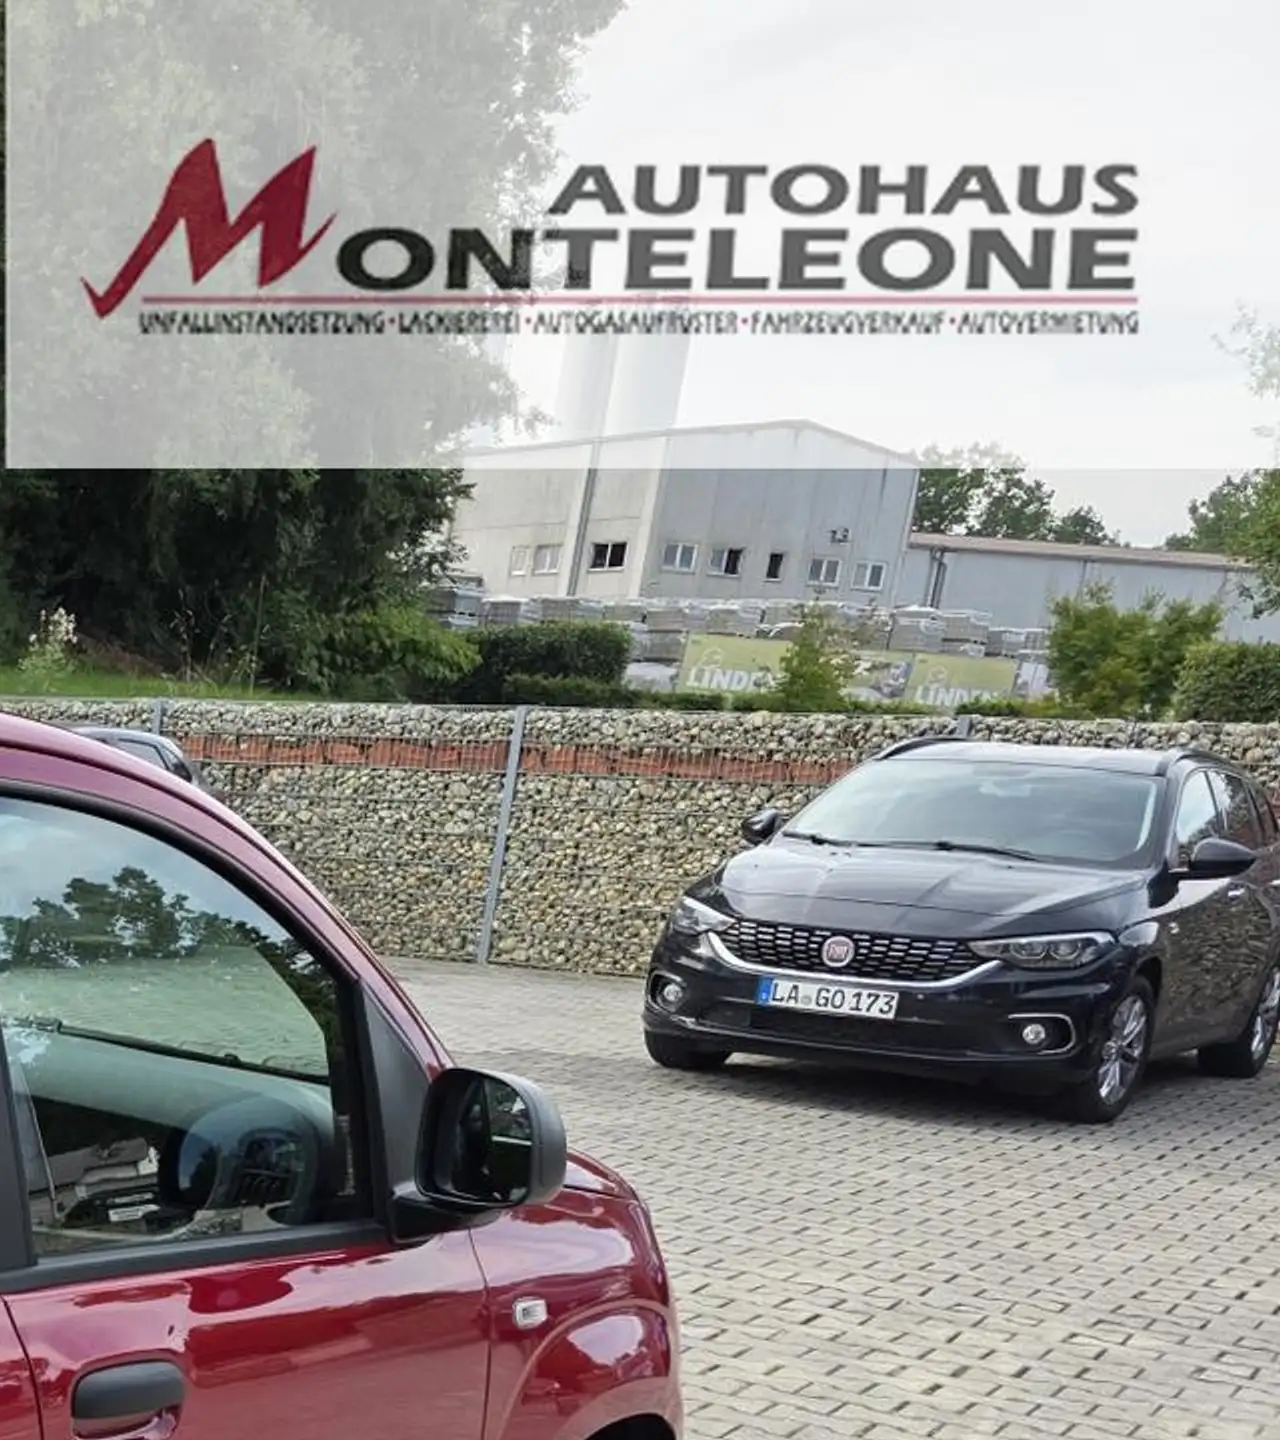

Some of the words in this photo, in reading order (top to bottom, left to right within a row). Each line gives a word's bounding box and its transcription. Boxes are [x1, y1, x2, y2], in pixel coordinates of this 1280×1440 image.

[772, 982, 800, 1004] LA
[815, 986, 846, 1009] GO
[848, 990, 896, 1015] 173
